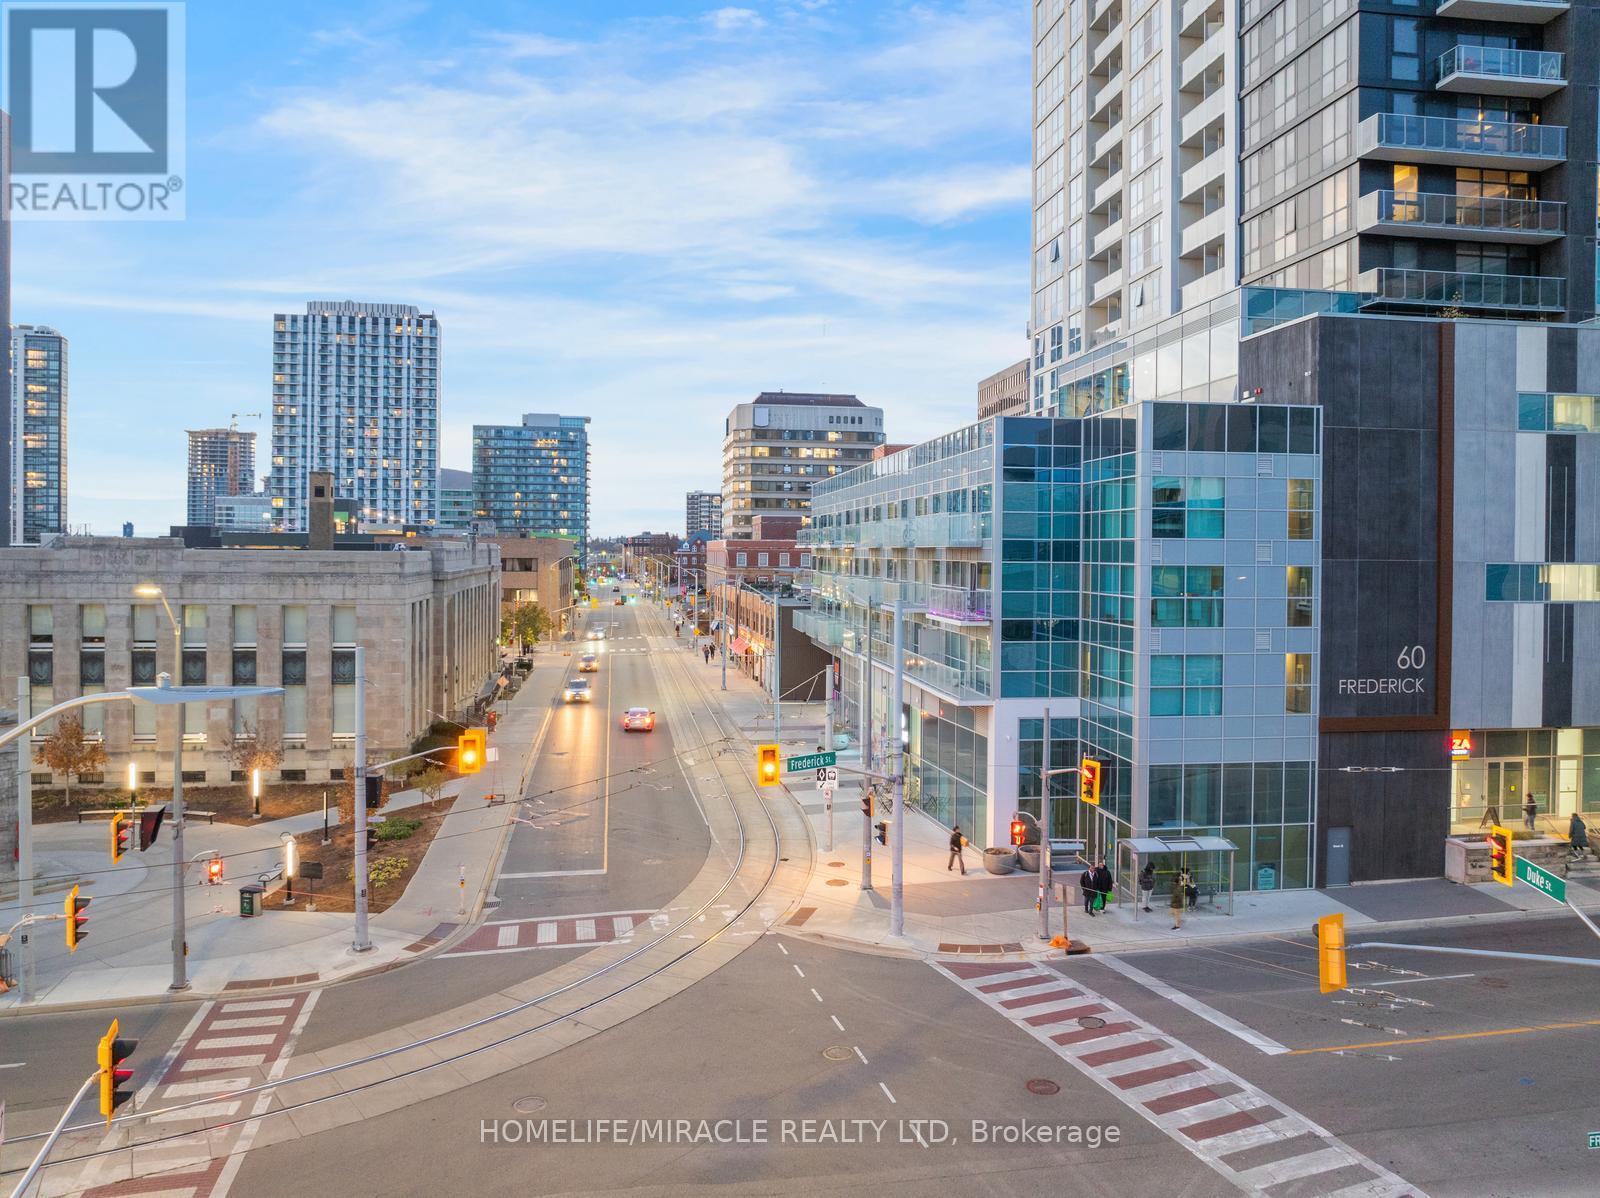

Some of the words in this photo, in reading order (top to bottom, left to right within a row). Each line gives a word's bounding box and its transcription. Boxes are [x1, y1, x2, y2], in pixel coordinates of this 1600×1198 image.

[1397, 645, 1426, 670] 60
[1338, 677, 1425, 695] FREDERICK
[790, 755, 825, 771] Frederick
[1526, 866, 1545, 889] Duke
